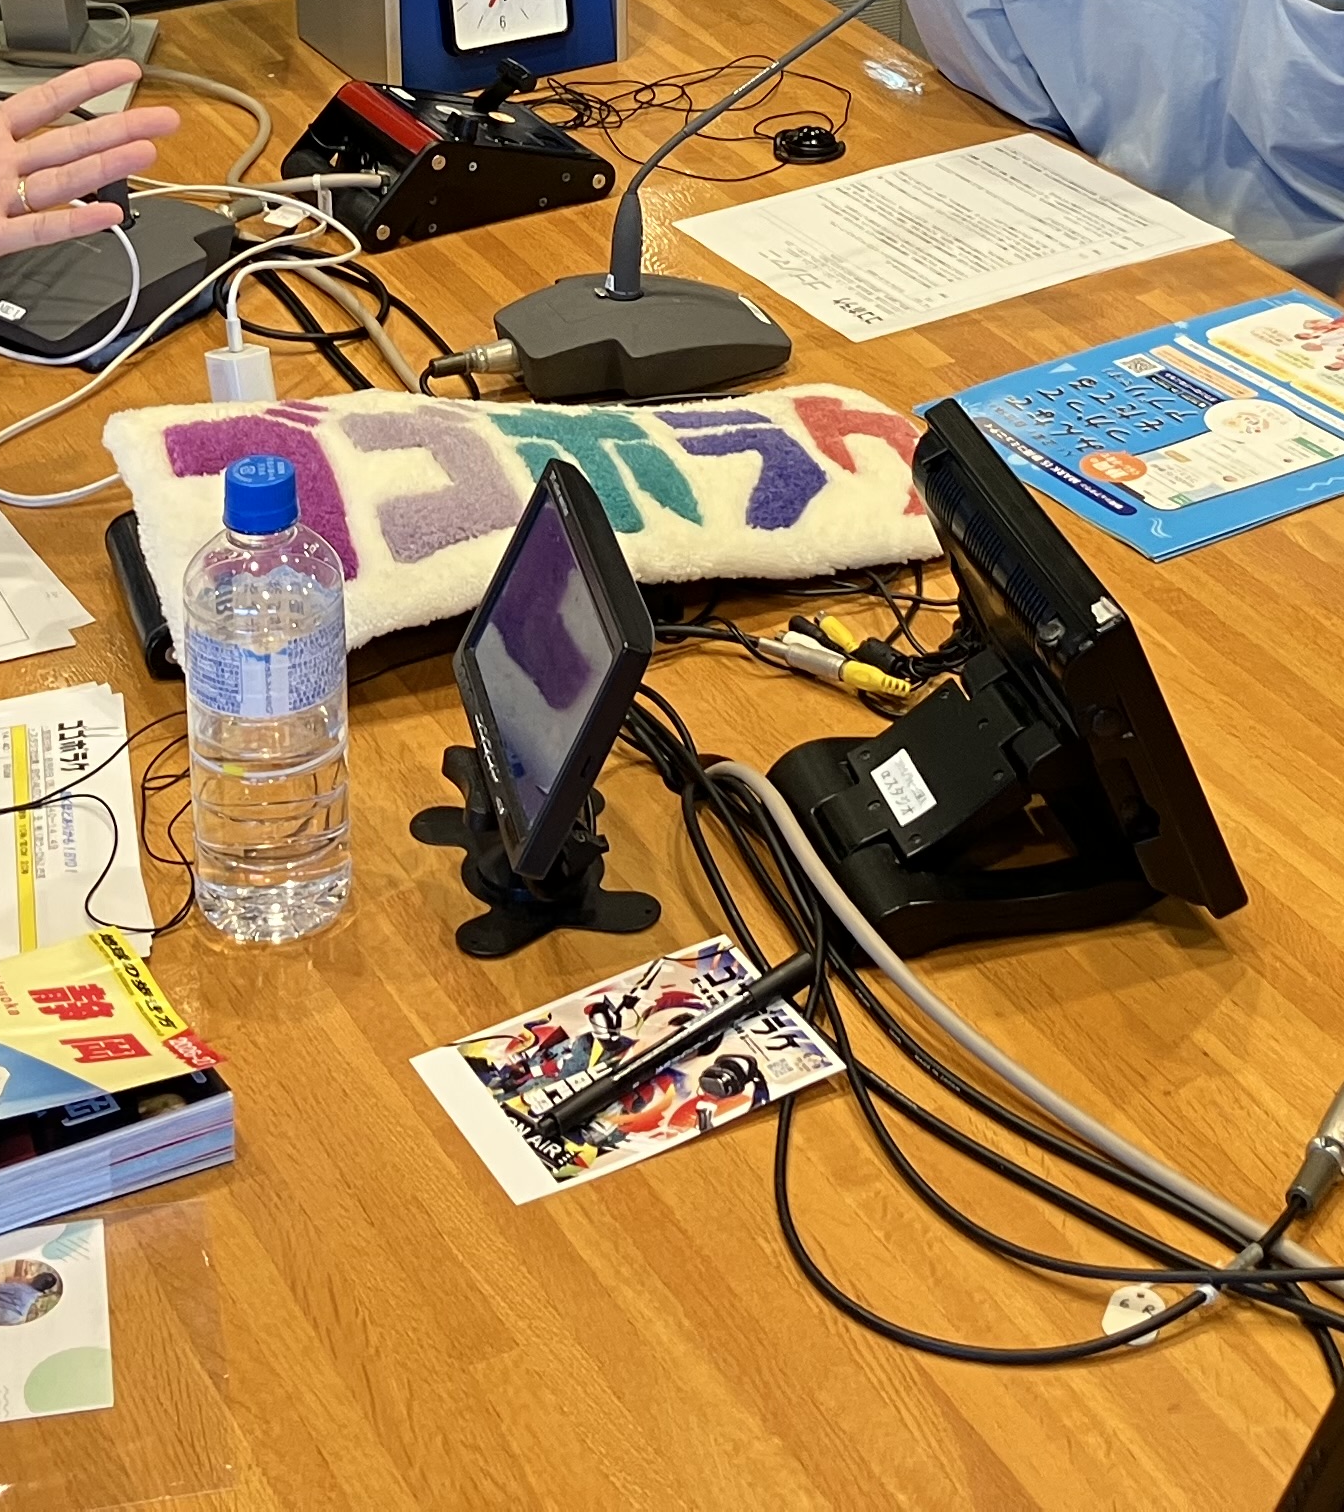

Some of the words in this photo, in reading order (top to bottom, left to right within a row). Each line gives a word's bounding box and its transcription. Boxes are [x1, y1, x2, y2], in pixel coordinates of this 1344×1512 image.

[499, 15, 507, 30] 6
[995, 394, 1114, 454] みんなで
[1027, 385, 1145, 444] つかって
[1059, 376, 1176, 434] そだてる
[1047, 465, 1083, 484] MARK
[57, 718, 92, 773] ゴゴボラケ
[89, 930, 189, 1032] 地球の歩き方
[22, 973, 155, 1072] 静岡
[527, 1133, 562, 1161] AIR
